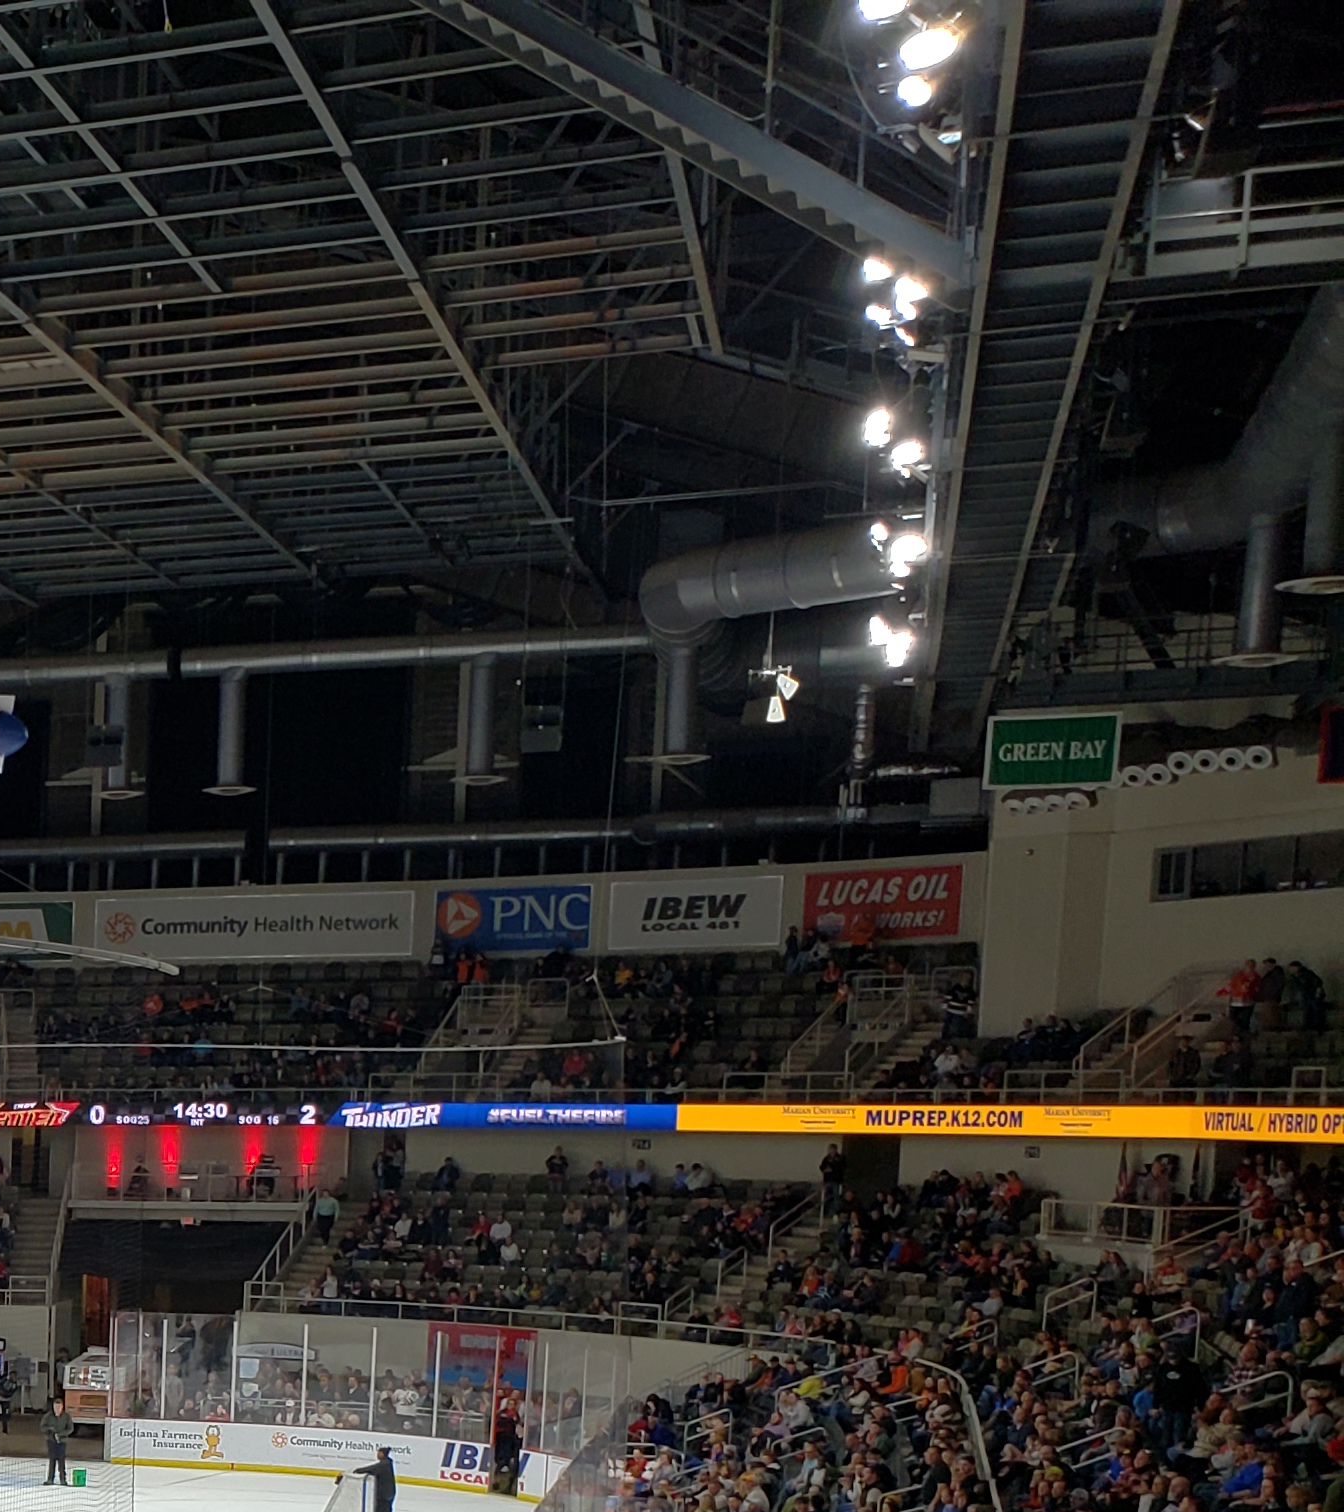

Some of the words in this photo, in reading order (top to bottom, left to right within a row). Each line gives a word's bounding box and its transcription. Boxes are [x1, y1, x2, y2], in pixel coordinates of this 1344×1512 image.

[998, 742, 1063, 762] GREEN
[1069, 739, 1107, 759] BAY
[816, 876, 903, 906] LUCAS
[907, 873, 949, 901] OIL
[490, 893, 590, 932] PNC
[641, 894, 748, 921] IBEW
[141, 915, 248, 938] Community
[254, 914, 314, 933] Health
[319, 912, 399, 933] Network
[641, 920, 702, 932] LOCAL
[706, 919, 741, 931] 481
[875, 910, 944, 928] WORKS!
[90, 1105, 105, 1124] 0
[173, 1103, 228, 1119] 14:30
[238, 1115, 261, 1125] SOG
[300, 1105, 316, 1124] 2
[341, 1104, 441, 1128] THUNDER
[487, 1108, 627, 1125] #FUELTHEFIRE
[866, 1109, 1023, 1128] MUPREP.K12.COM
[190, 1118, 205, 1127] INT
[1204, 1112, 1254, 1132] VIRTUAL
[1268, 1112, 1317, 1134] HYBRID
[119, 1428, 159, 1438] Indiana
[162, 1430, 203, 1440] Farmers
[290, 1436, 343, 1451] Community
[345, 1440, 374, 1451] Health
[153, 1439, 203, 1450] Insurance
